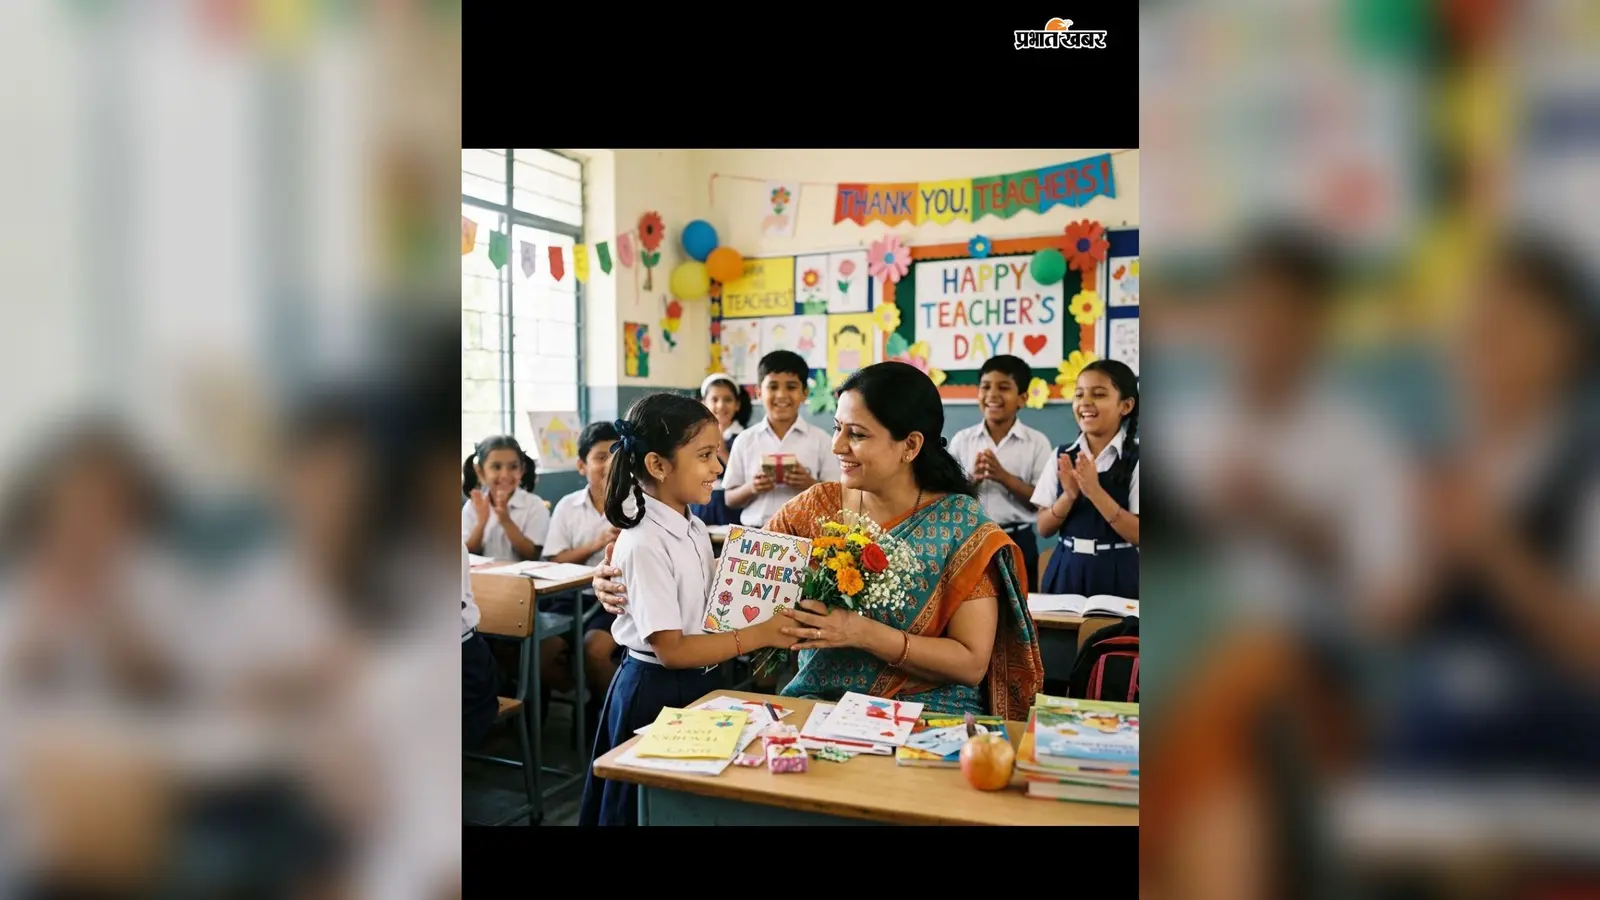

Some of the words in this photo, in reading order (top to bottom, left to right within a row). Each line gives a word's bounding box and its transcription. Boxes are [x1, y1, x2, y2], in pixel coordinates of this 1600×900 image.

[840, 190, 915, 216] THANK
[920, 188, 969, 215] YOU,
[973, 161, 1110, 211] TEACHERS!
[943, 263, 1027, 294] HAPPY
[920, 293, 1056, 328] TEACHER'S
[954, 332, 1014, 360] DAY!
[740, 539, 789, 561] HAPPY
[728, 557, 802, 585] TEACHER'S
[741, 580, 780, 603] DAY!
